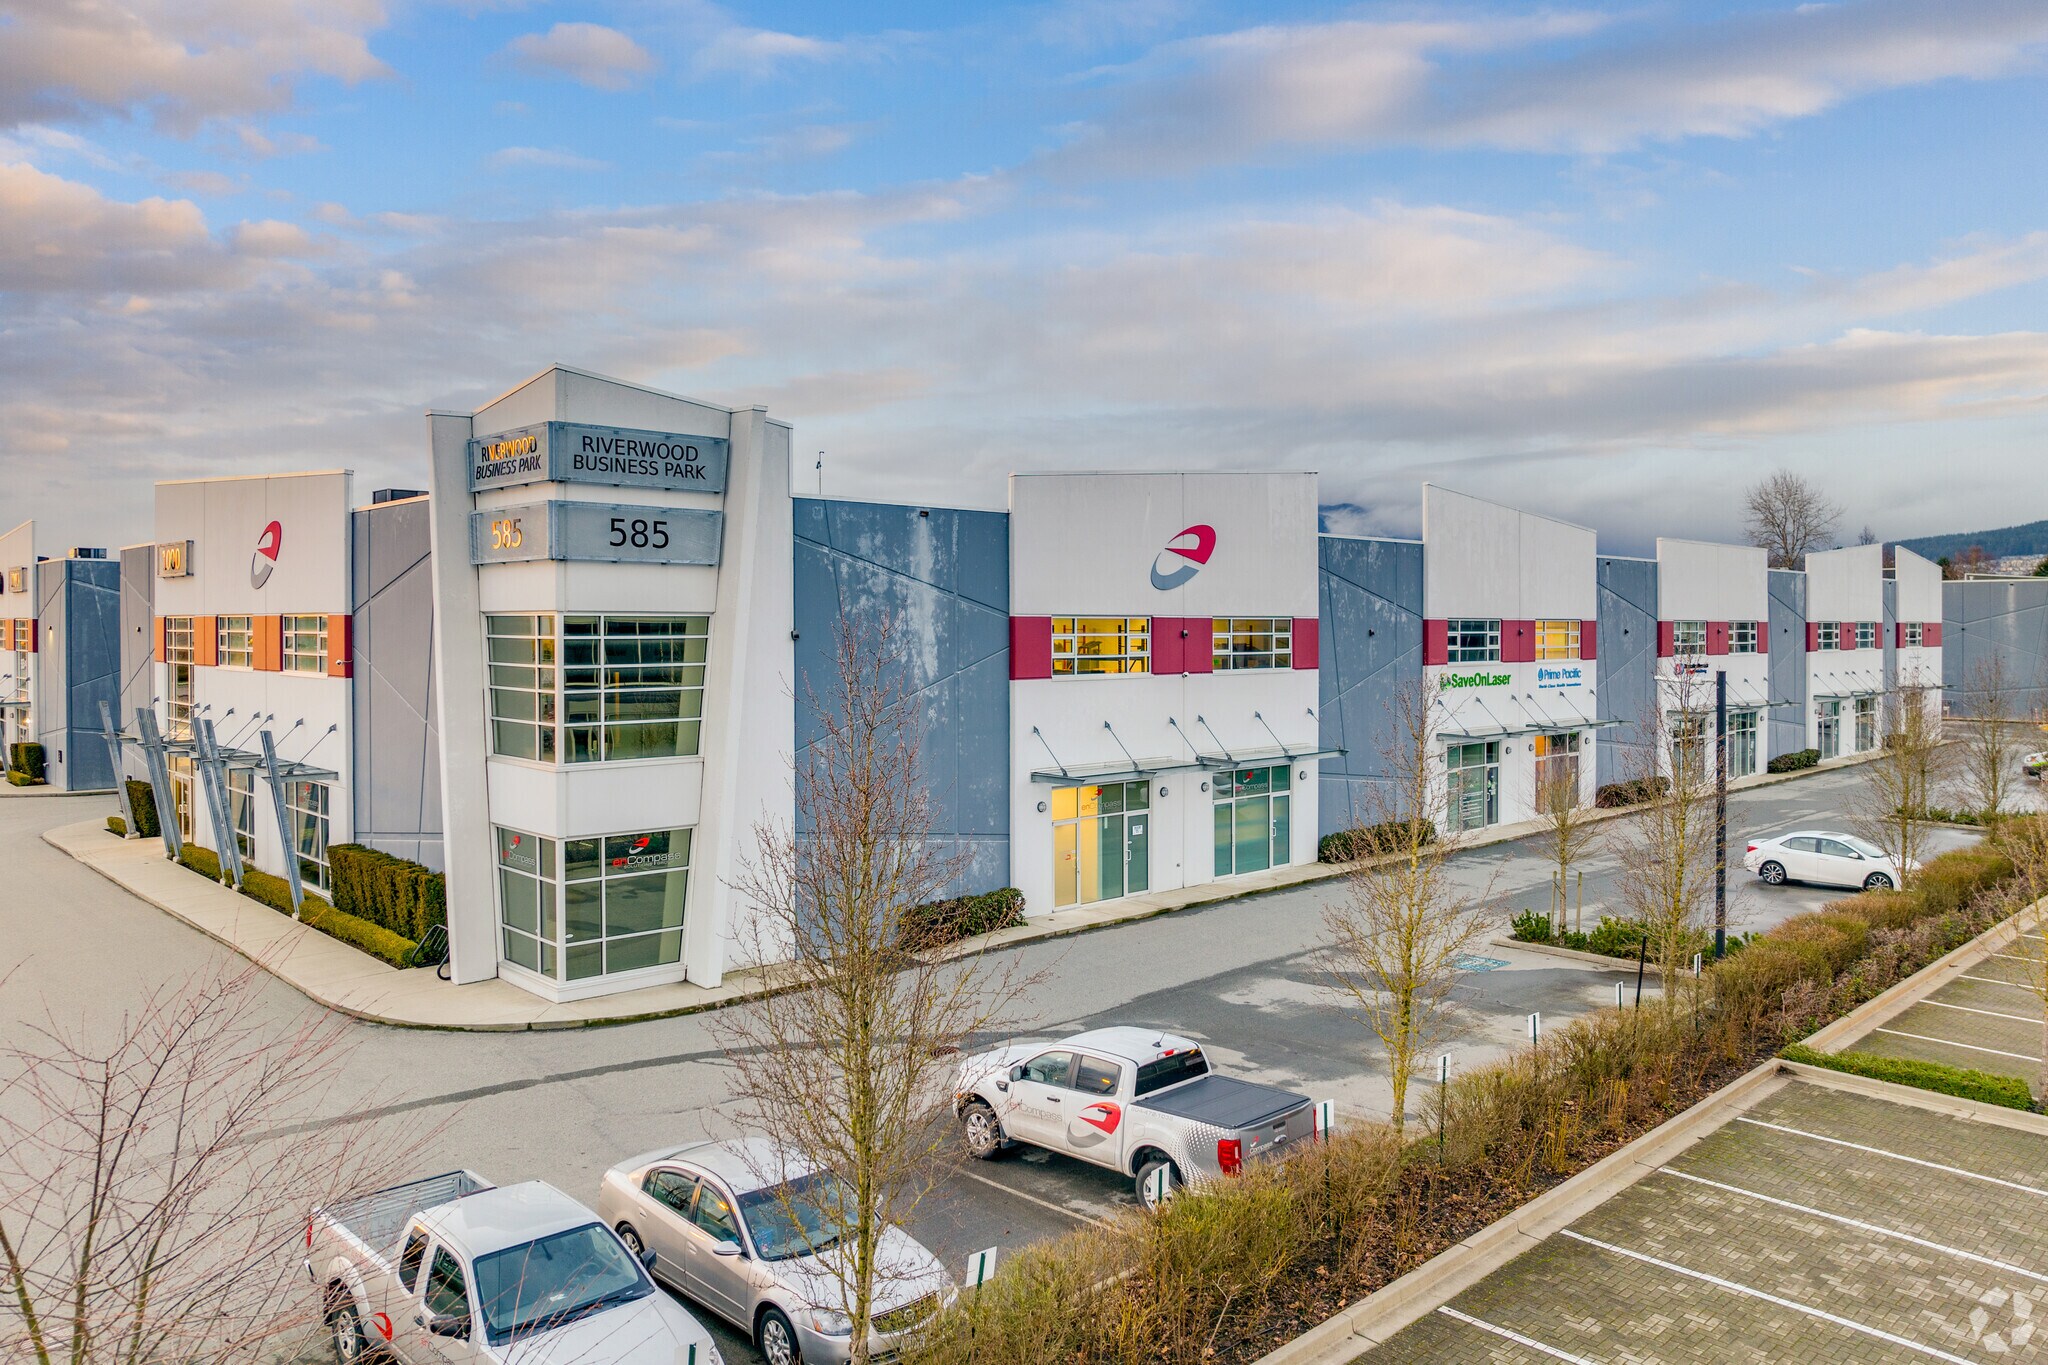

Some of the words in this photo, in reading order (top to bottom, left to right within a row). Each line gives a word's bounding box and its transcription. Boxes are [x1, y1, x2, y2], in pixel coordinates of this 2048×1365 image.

[481, 435, 537, 463] RIVERWOOD
[582, 435, 699, 462] RIVERWOOD
[475, 459, 517, 480] BUSINESS
[518, 454, 541, 473] PARK
[573, 454, 659, 476] BUSINESS
[665, 462, 707, 480] PARK
[491, 518, 522, 550] 585
[609, 517, 670, 549] 585
[1451, 671, 1512, 688] SaveOnLaser
[1544, 669, 1561, 679] Prime
[1562, 667, 1582, 678] Pacific
[612, 852, 681, 867] enCompass
